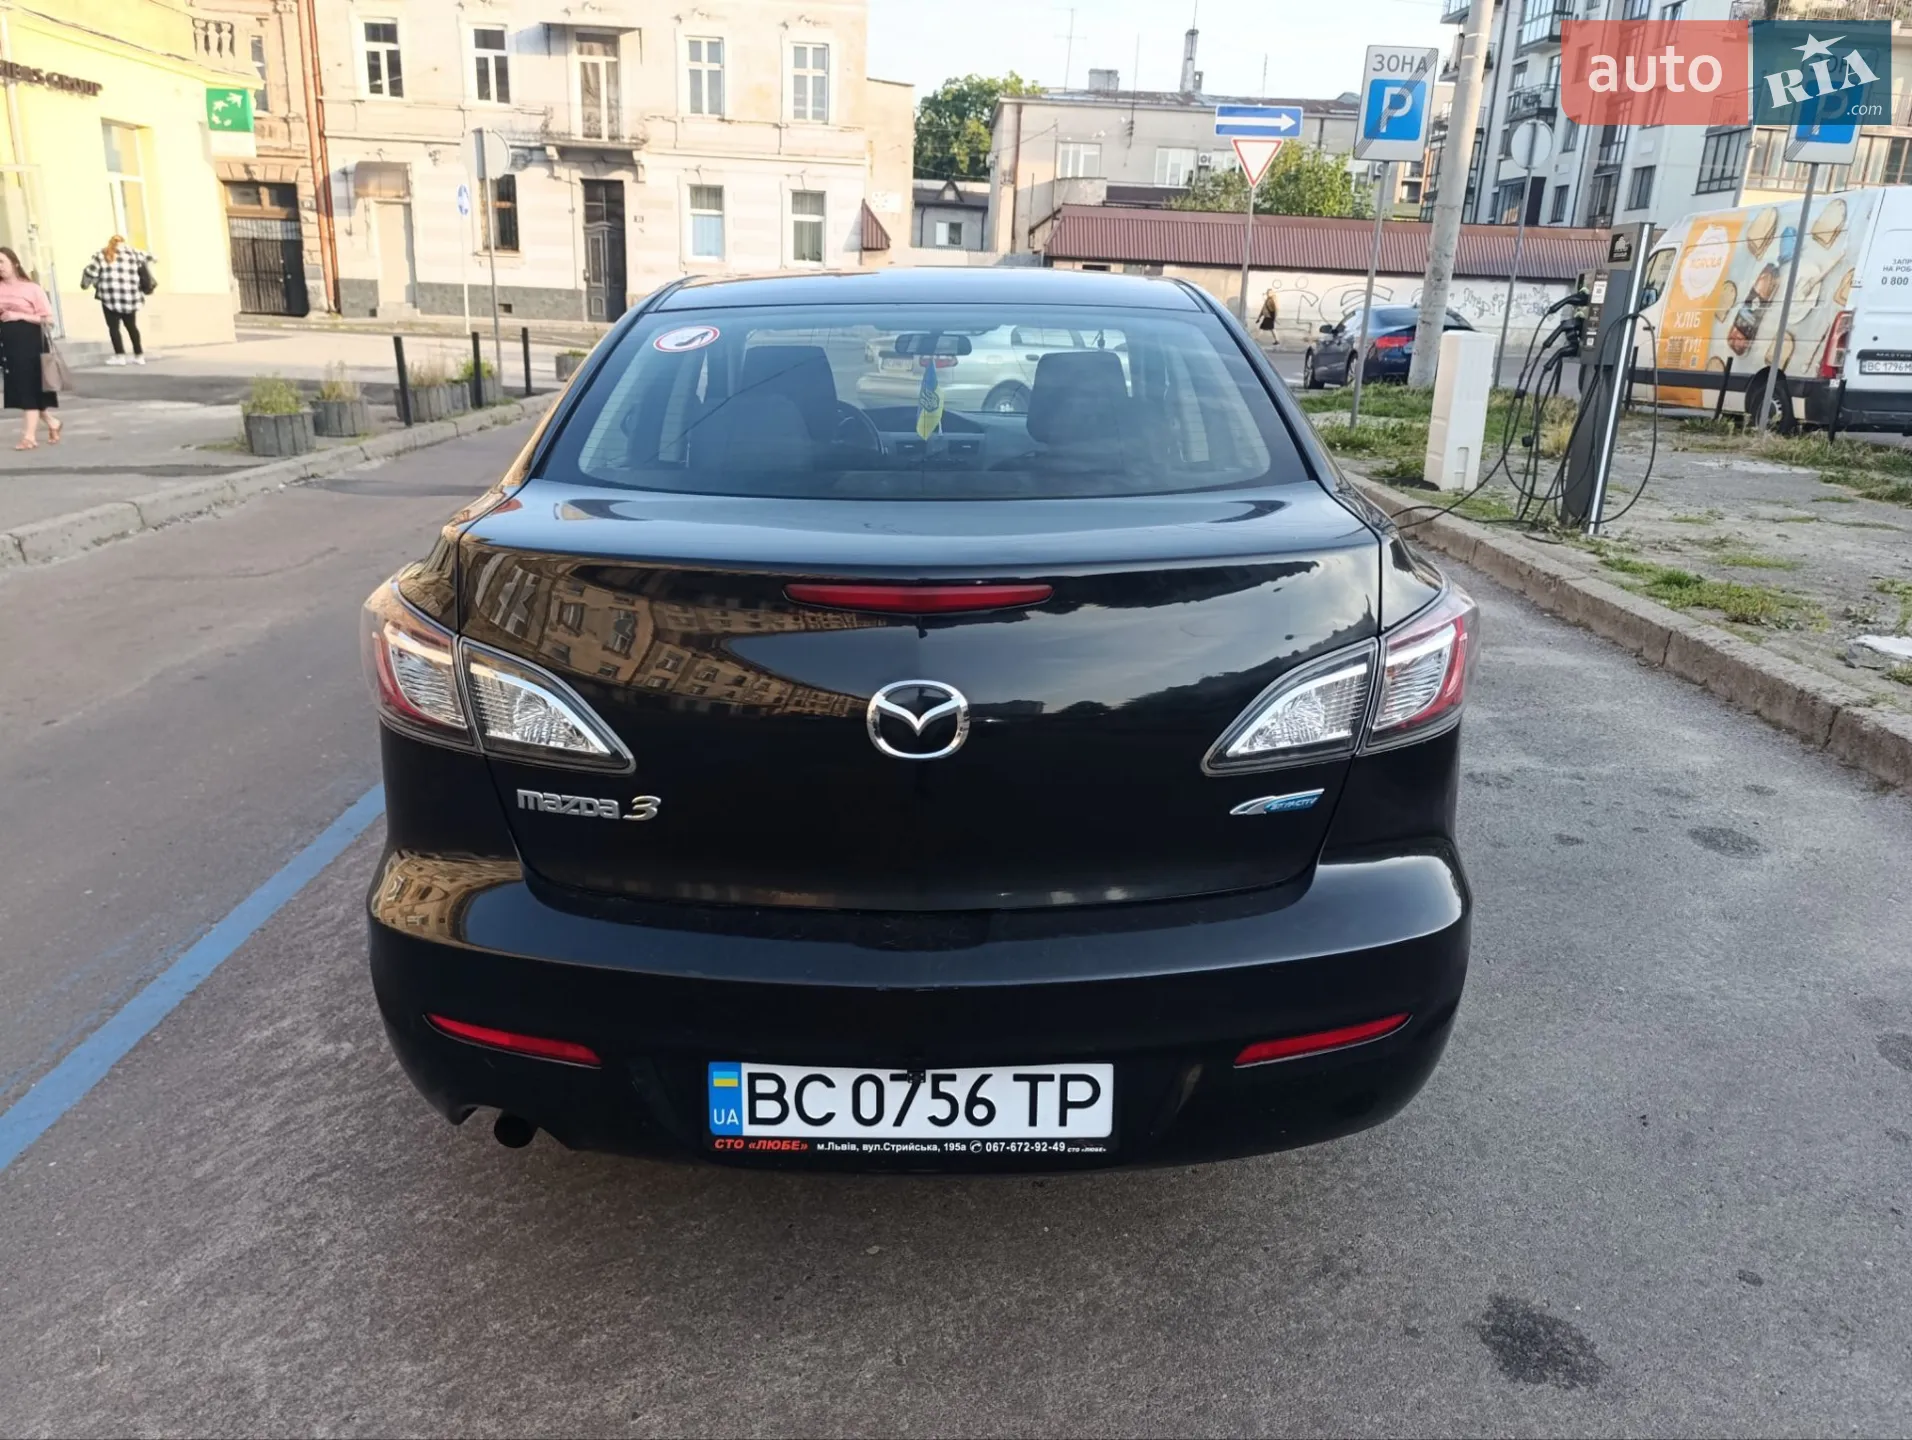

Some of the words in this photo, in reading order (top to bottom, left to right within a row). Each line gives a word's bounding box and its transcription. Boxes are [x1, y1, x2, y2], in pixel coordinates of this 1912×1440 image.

[1372, 54, 1428, 73] ЗОНА
[1380, 86, 1413, 133] P
[1881, 276, 1888, 285] 0
[1890, 276, 1909, 286] 800
[1673, 311, 1702, 328] ХЛІБ
[622, 795, 662, 821] 3
[747, 1072, 836, 1127] BC
[852, 1072, 996, 1127] 0756
[1012, 1073, 1101, 1127] TP
[713, 1108, 739, 1125] UA
[714, 1139, 744, 1150] СТО
[748, 1140, 808, 1151] «ЛЮБЕ»
[985, 1142, 1066, 1152] 067-672-92-49
